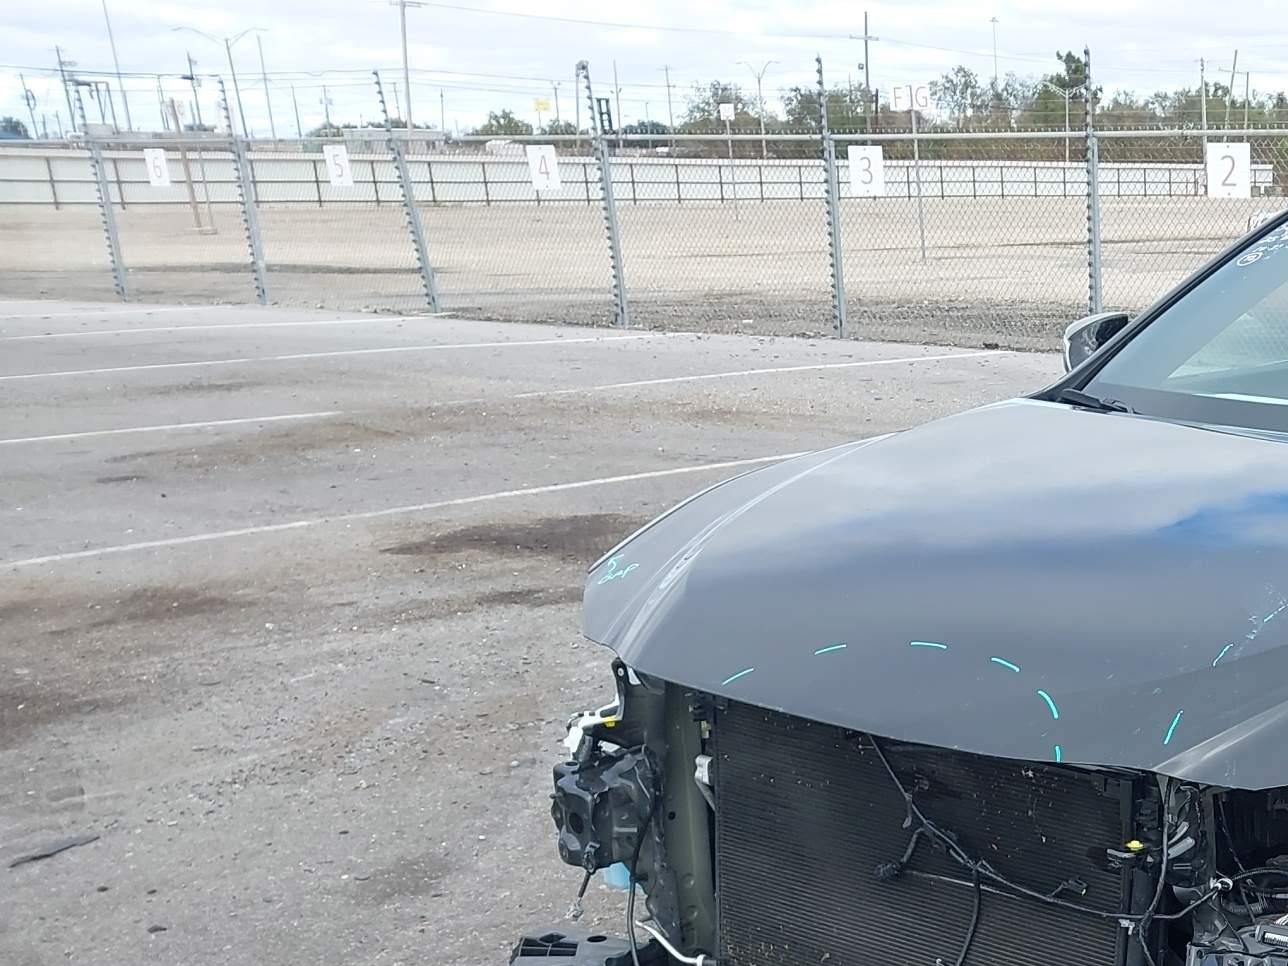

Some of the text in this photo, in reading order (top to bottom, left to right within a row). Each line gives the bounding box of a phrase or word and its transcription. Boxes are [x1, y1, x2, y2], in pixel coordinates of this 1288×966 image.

[152, 156, 162, 179] 6
[332, 153, 344, 178] 5
[539, 154, 550, 181] 4
[859, 155, 874, 185] 3
[1219, 154, 1237, 188] 2
